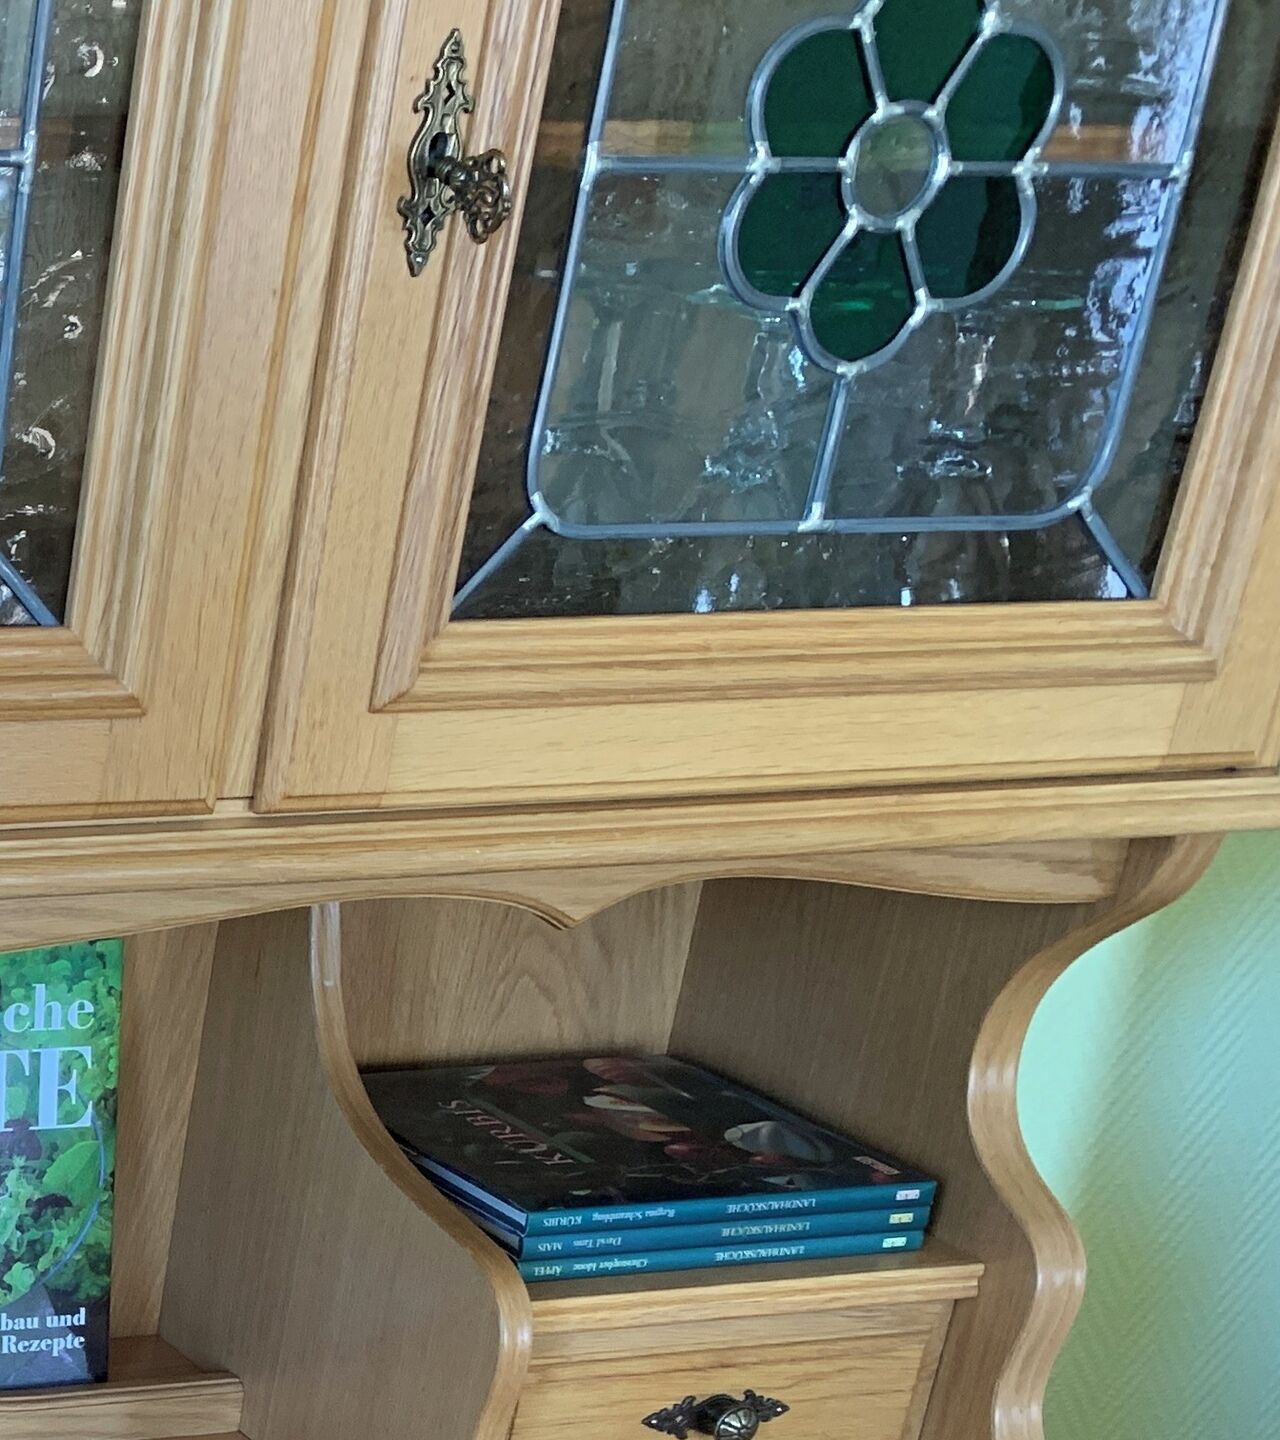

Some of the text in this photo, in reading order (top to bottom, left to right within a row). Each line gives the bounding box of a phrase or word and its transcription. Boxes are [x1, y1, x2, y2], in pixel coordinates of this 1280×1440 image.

[543, 1215, 582, 1227] KÜRBIS
[538, 1242, 563, 1252] MAIS
[534, 1265, 563, 1277] ÄPFEL
[46, 1307, 86, 1329] und
[1, 1332, 85, 1357] Rezepte
